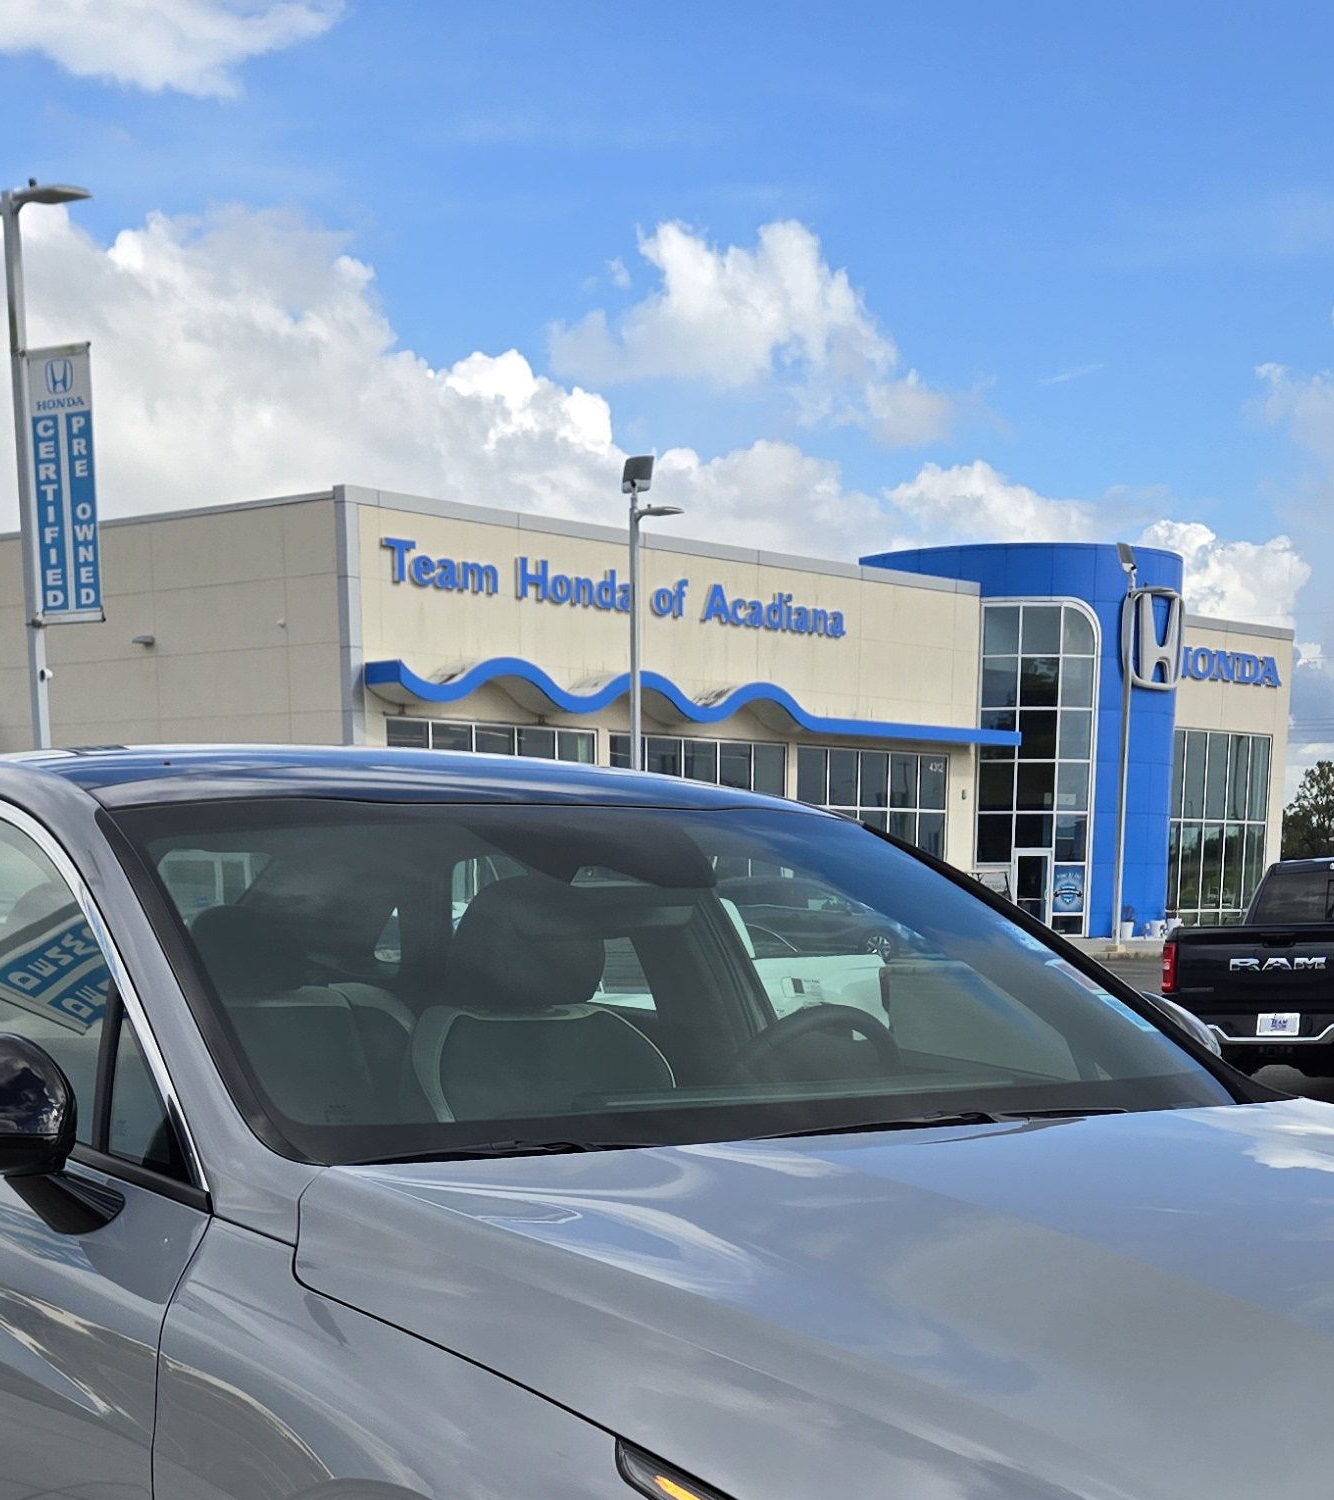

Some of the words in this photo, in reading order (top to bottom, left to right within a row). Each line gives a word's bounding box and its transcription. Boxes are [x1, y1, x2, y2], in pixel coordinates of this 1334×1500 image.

[36, 396, 85, 411] HONDA
[71, 416, 88, 478] PRE
[36, 419, 65, 607] CERTIFIED
[74, 502, 95, 606] OWNED
[381, 537, 499, 595] Team
[515, 557, 633, 613] Honda
[650, 579, 689, 618] of
[700, 584, 847, 638] Acadiana
[1229, 956, 1327, 972] RAM
